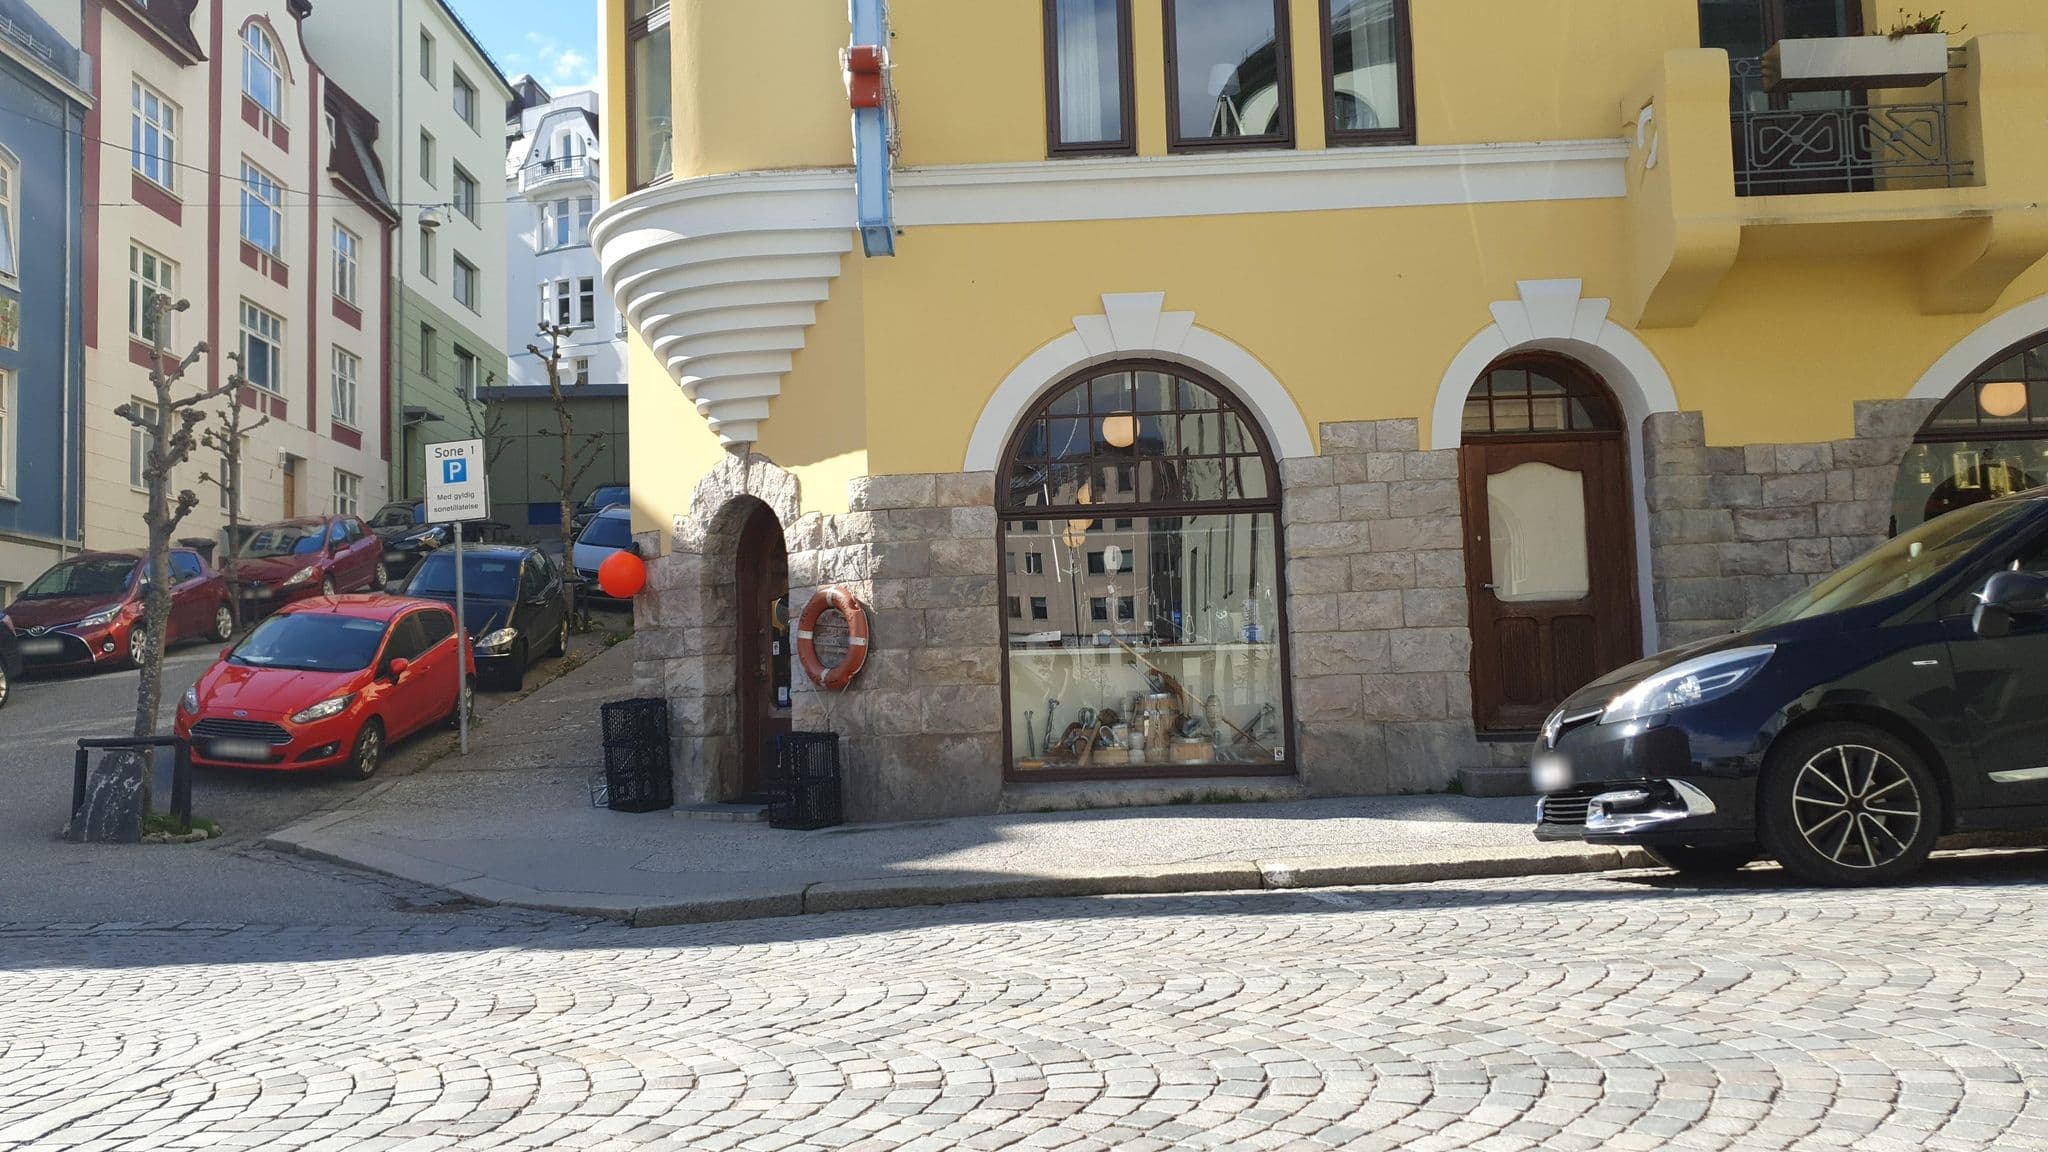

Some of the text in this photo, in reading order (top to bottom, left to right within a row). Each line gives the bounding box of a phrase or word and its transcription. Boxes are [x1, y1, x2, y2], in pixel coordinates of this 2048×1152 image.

[435, 445, 475, 458] Sone 1
[449, 461, 462, 480] P
[437, 492, 475, 501] Med gyldig
